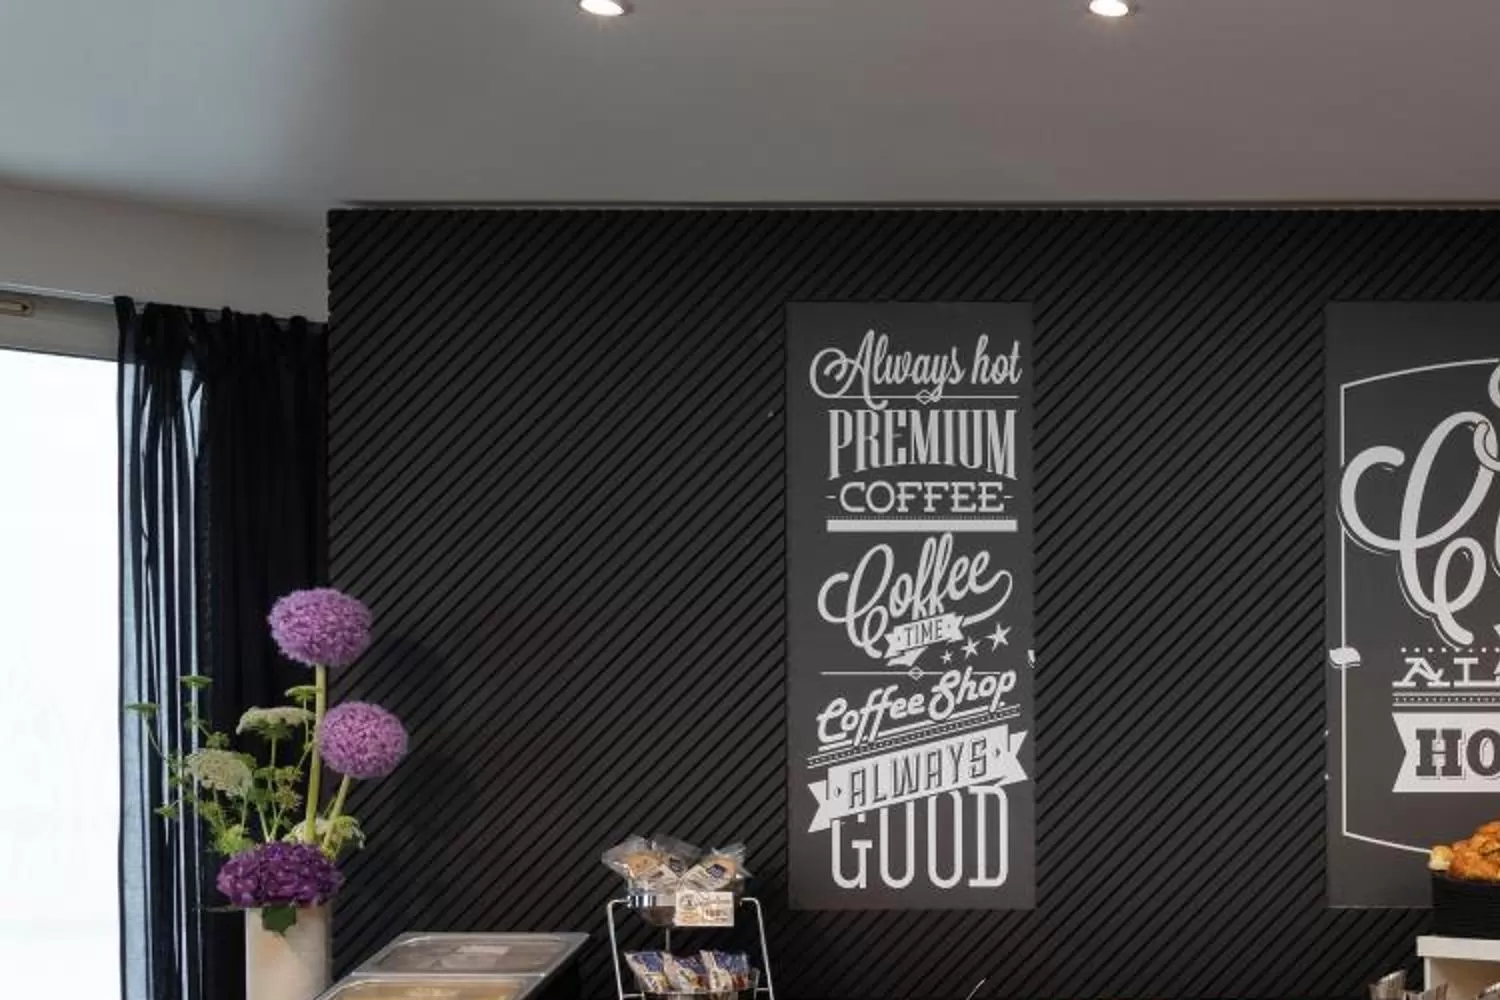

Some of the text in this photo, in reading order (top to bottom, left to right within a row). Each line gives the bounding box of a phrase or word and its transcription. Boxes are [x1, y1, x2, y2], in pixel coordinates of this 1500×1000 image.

[810, 329, 1023, 410] Always hot
[828, 409, 1018, 480] PREMIUM
[839, 481, 1005, 513] COFFEE
[817, 533, 1014, 659] Coffee
[903, 619, 943, 646] TIME
[816, 665, 1017, 747] Coffee Shop
[848, 735, 987, 809] ALWAYS
[831, 785, 1009, 889] GOOD
